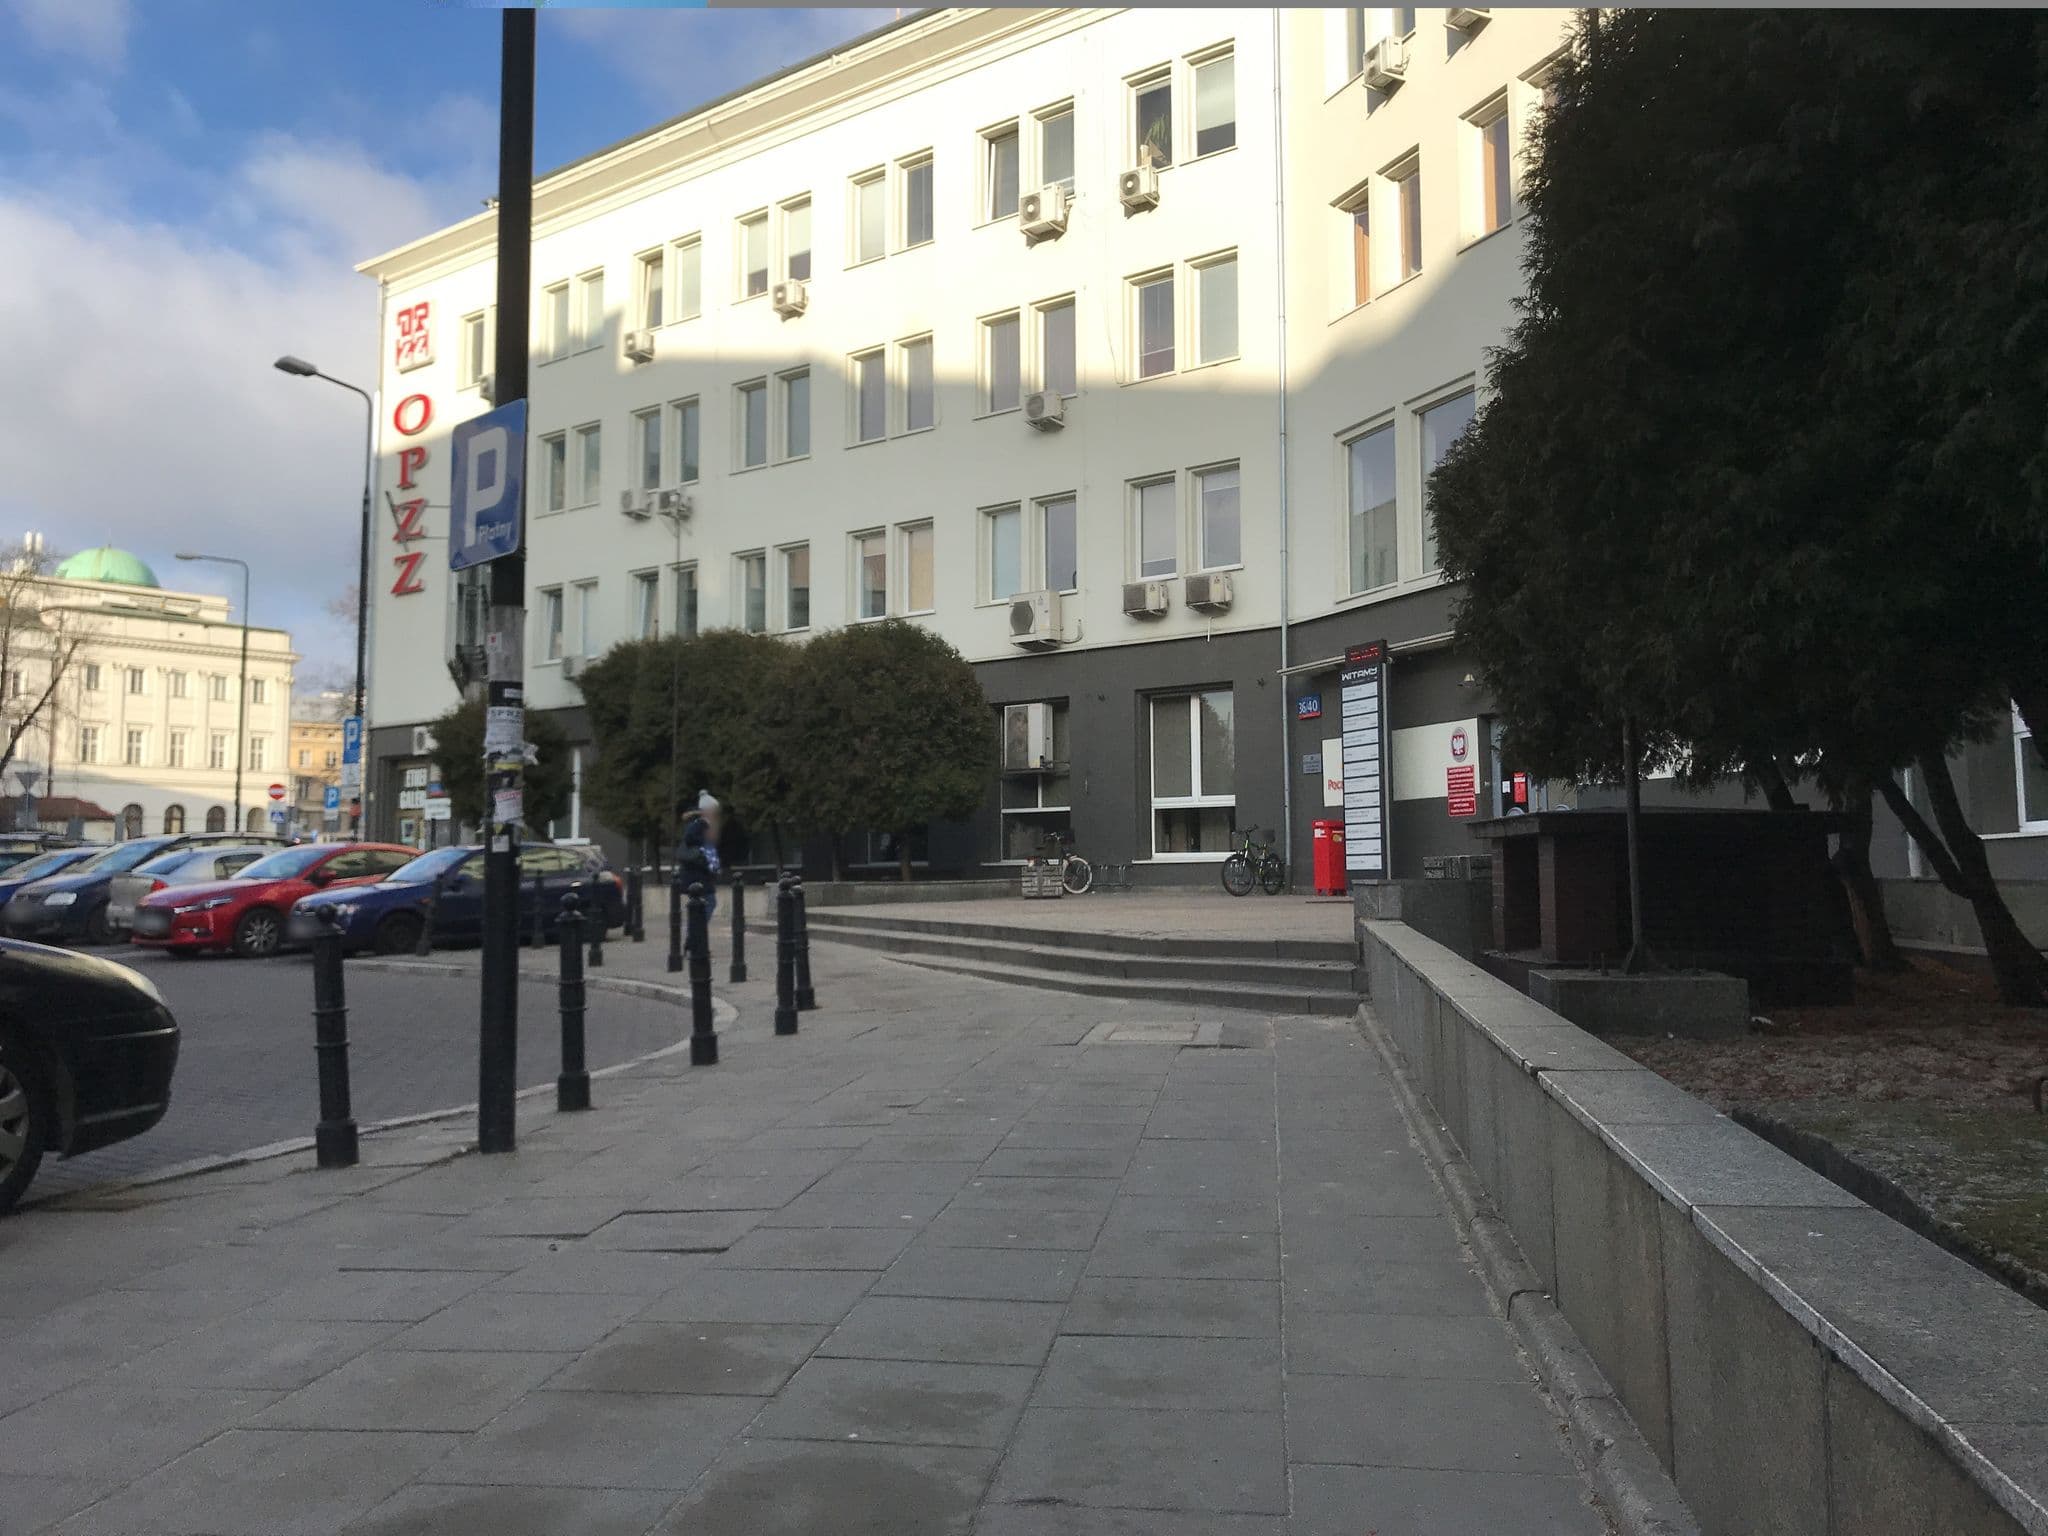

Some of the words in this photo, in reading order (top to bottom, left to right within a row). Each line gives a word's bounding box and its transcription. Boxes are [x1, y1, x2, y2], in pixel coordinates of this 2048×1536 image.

[391, 393, 432, 597] OPZZ
[464, 426, 508, 549] P
[1341, 666, 1378, 682] WITAMY
[346, 721, 359, 750] P
